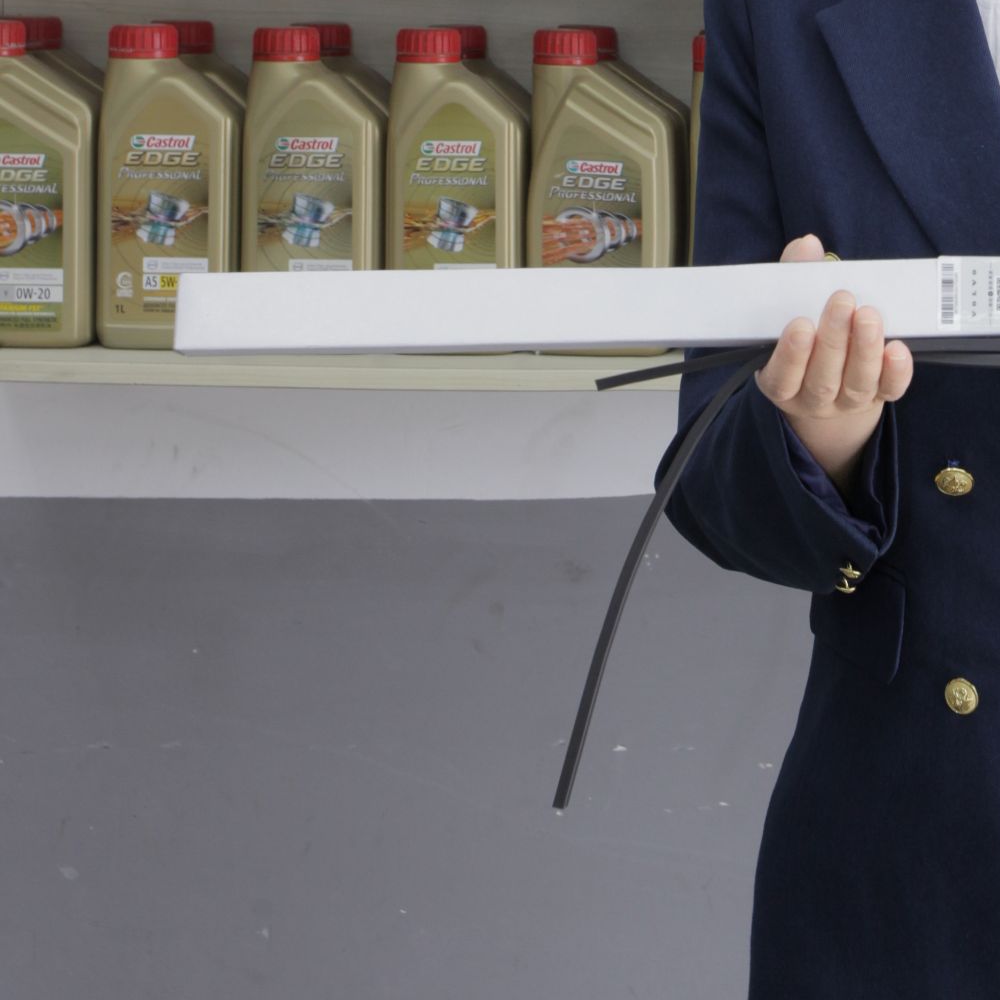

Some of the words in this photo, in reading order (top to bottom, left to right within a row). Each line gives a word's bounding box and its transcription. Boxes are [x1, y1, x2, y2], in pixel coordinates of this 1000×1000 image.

[145, 136, 190, 149] Castrol
[290, 138, 332, 150] Castrol
[434, 142, 477, 154] Castrol
[2, 155, 41, 165] Castrol
[125, 152, 200, 166] EDGE
[270, 154, 342, 168] EDGE
[416, 158, 485, 172] EDGE
[579, 162, 620, 173] Castrol
[0, 169, 48, 182] DGE
[563, 176, 626, 190] EDGE
[160, 275, 177, 287] 5W-
[16, 288, 50, 299] 0W-20
